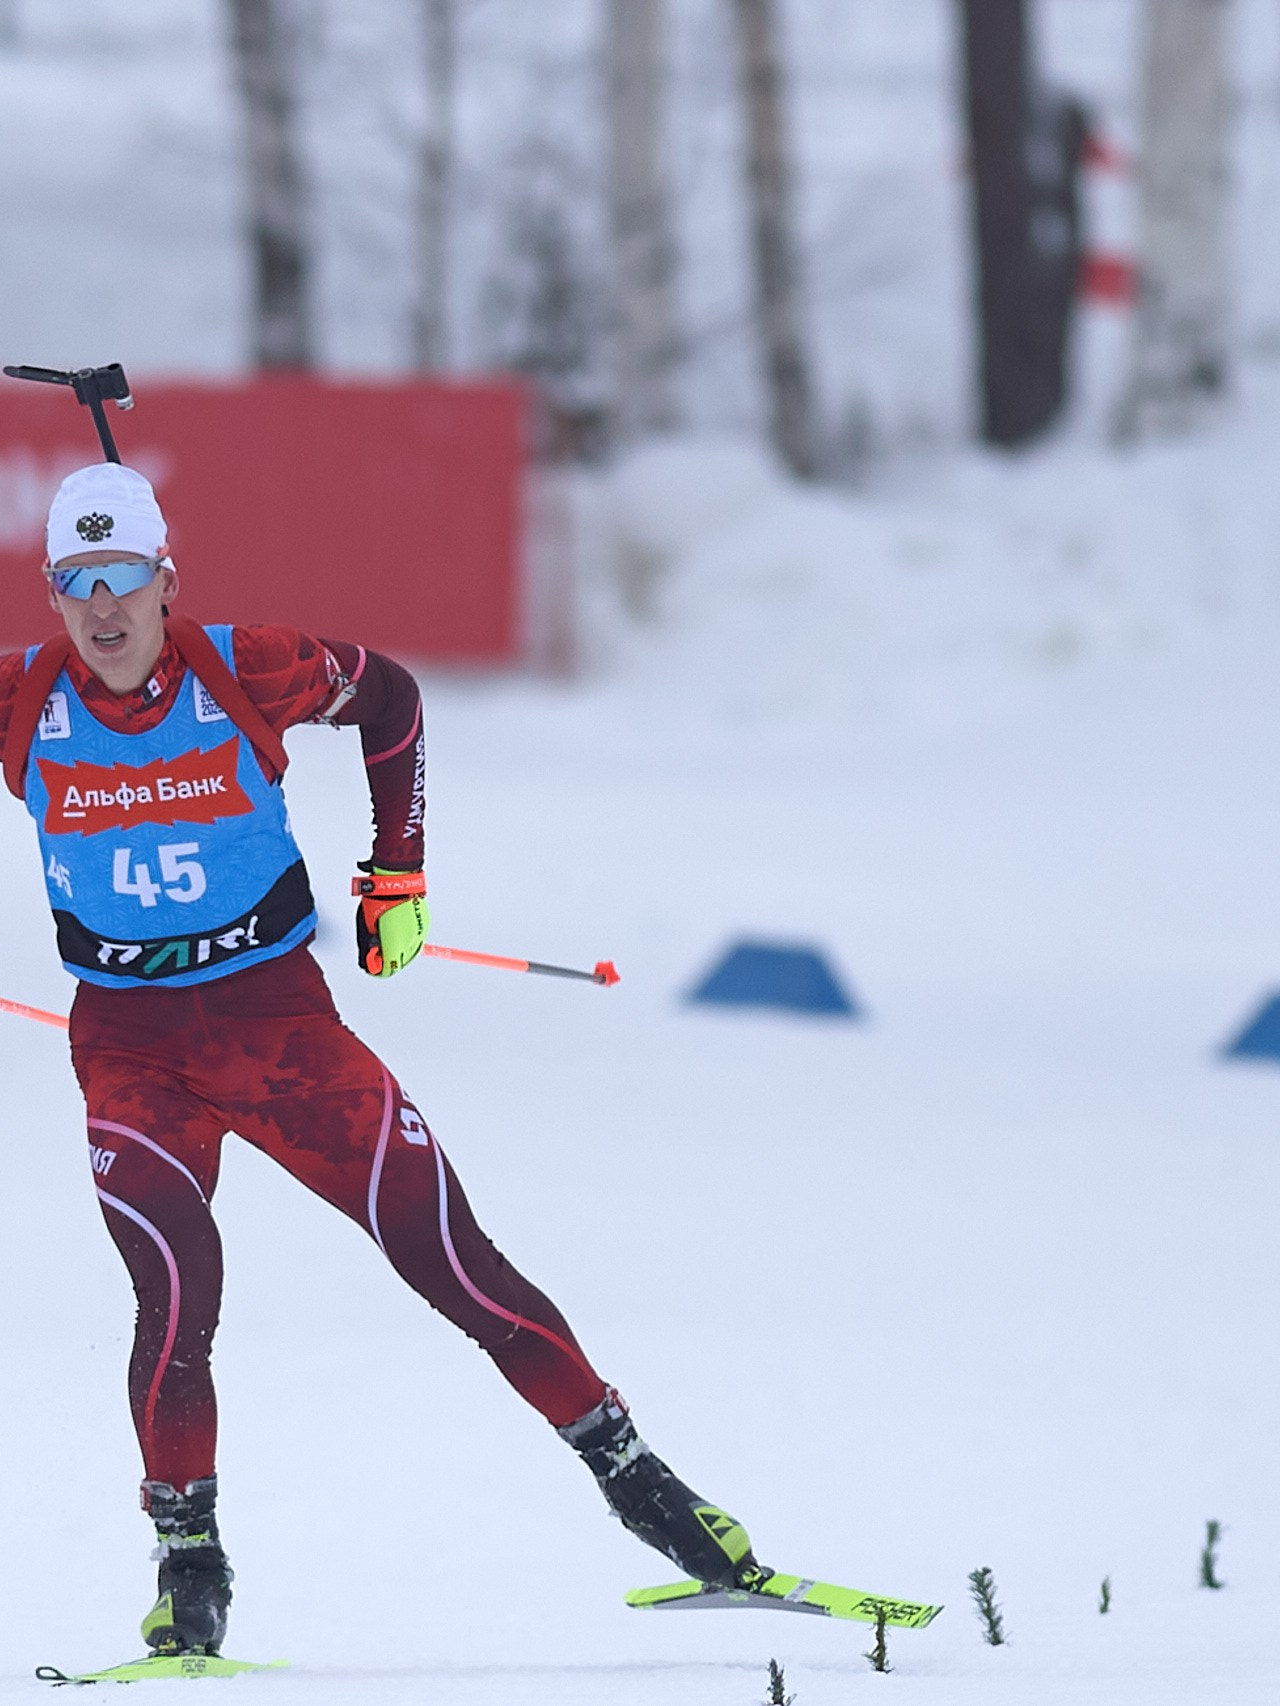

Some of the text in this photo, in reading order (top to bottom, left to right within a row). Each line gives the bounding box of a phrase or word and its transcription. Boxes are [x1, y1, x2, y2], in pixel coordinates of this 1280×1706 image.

[63, 775, 228, 810] Альфа Банк
[47, 854, 74, 898] 45
[112, 841, 207, 908] 45
